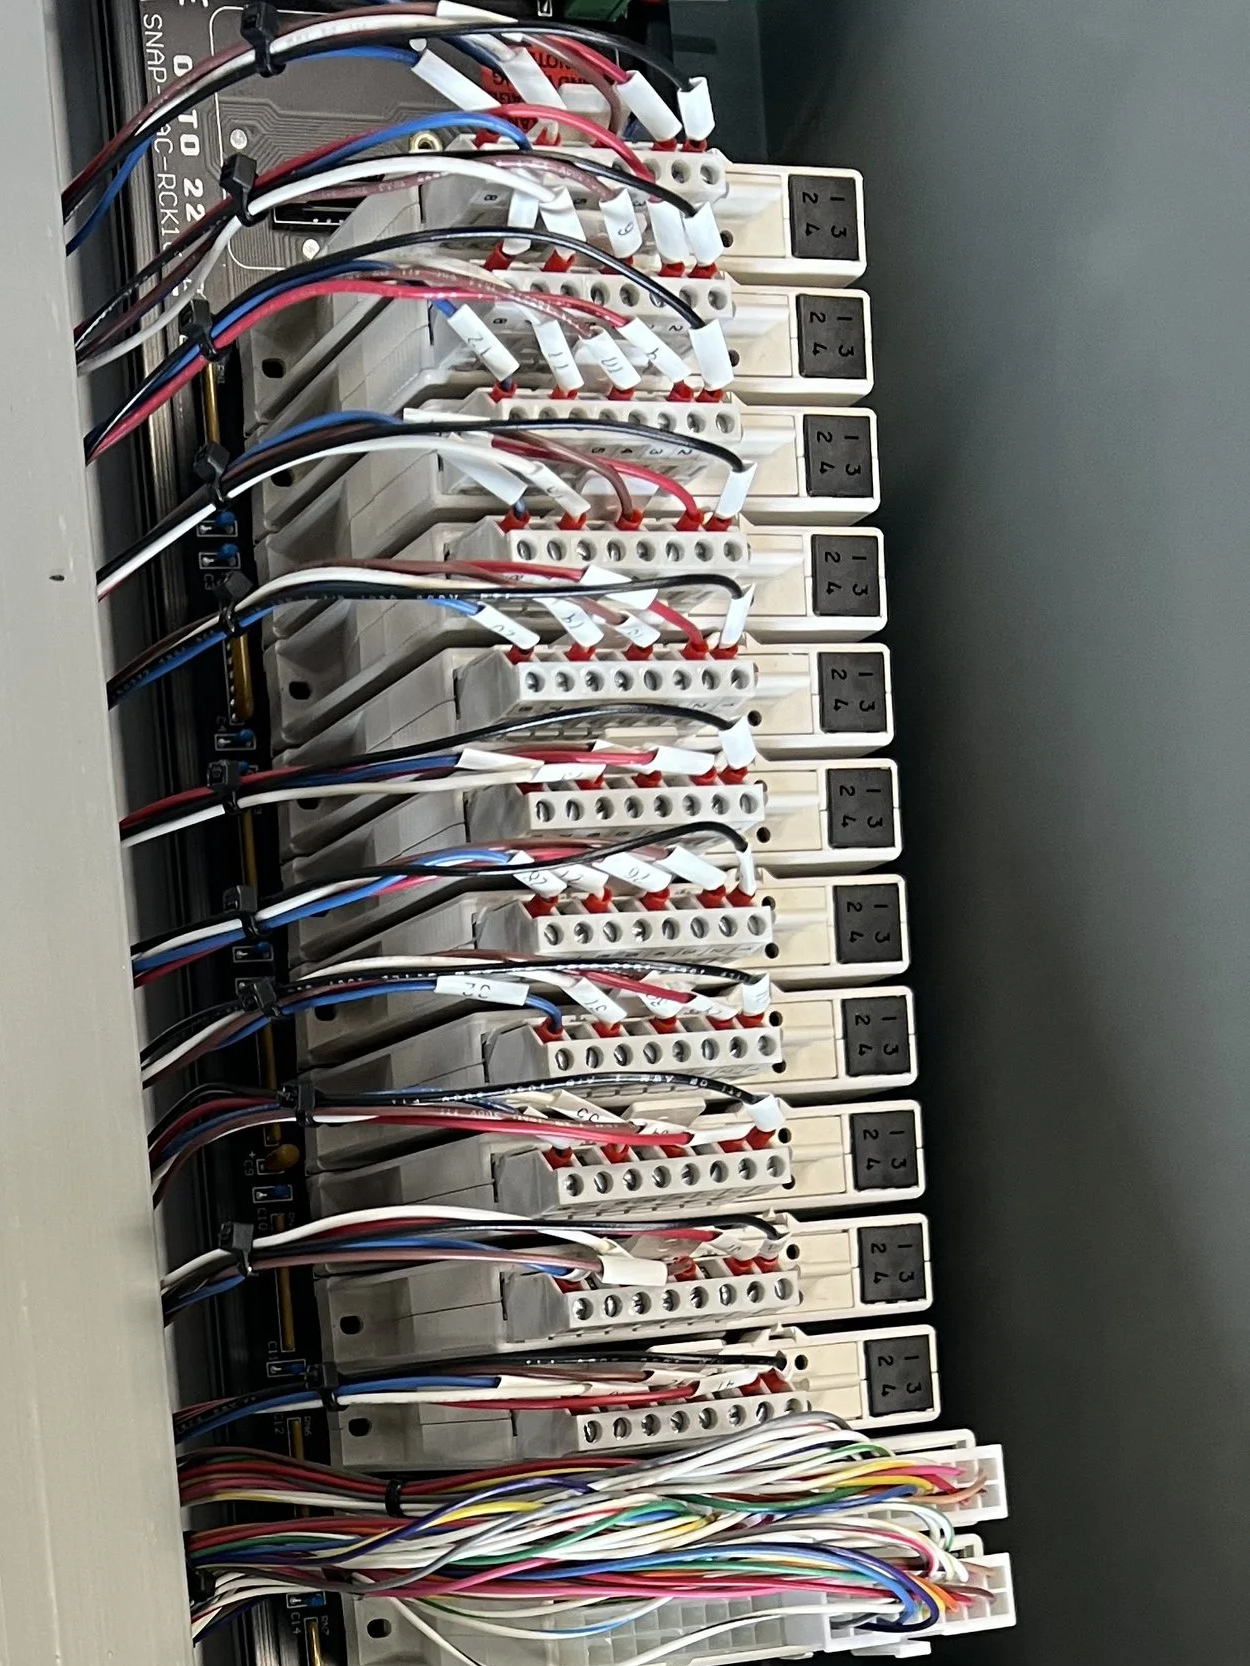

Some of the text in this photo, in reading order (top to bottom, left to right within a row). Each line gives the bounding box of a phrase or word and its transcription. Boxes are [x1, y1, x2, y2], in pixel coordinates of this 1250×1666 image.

[184, 177, 205, 222] 22
[802, 191, 820, 237] 2 4
[831, 225, 847, 239] 3
[809, 311, 828, 357] 2 4
[838, 344, 855, 358] 3
[816, 430, 836, 475] 2 4
[845, 463, 861, 477] 3
[824, 551, 842, 595] 2 4
[852, 583, 868, 597] 3
[831, 668, 849, 712] 2 4
[859, 700, 875, 713] 3
[839, 784, 857, 828] 2 4
[867, 815, 883, 829] 3
[846, 900, 864, 944] 2 4
[875, 931, 890, 944] 3
[855, 1013, 873, 1057] 2 4
[883, 1043, 899, 1056] 3
[863, 1128, 881, 1171] 2 4
[891, 1157, 907, 1170] 3
[870, 1243, 889, 1285] 2 4
[899, 1270, 915, 1284] 3
[877, 1354, 897, 1397] 2 4
[906, 1381, 922, 1394] 3
